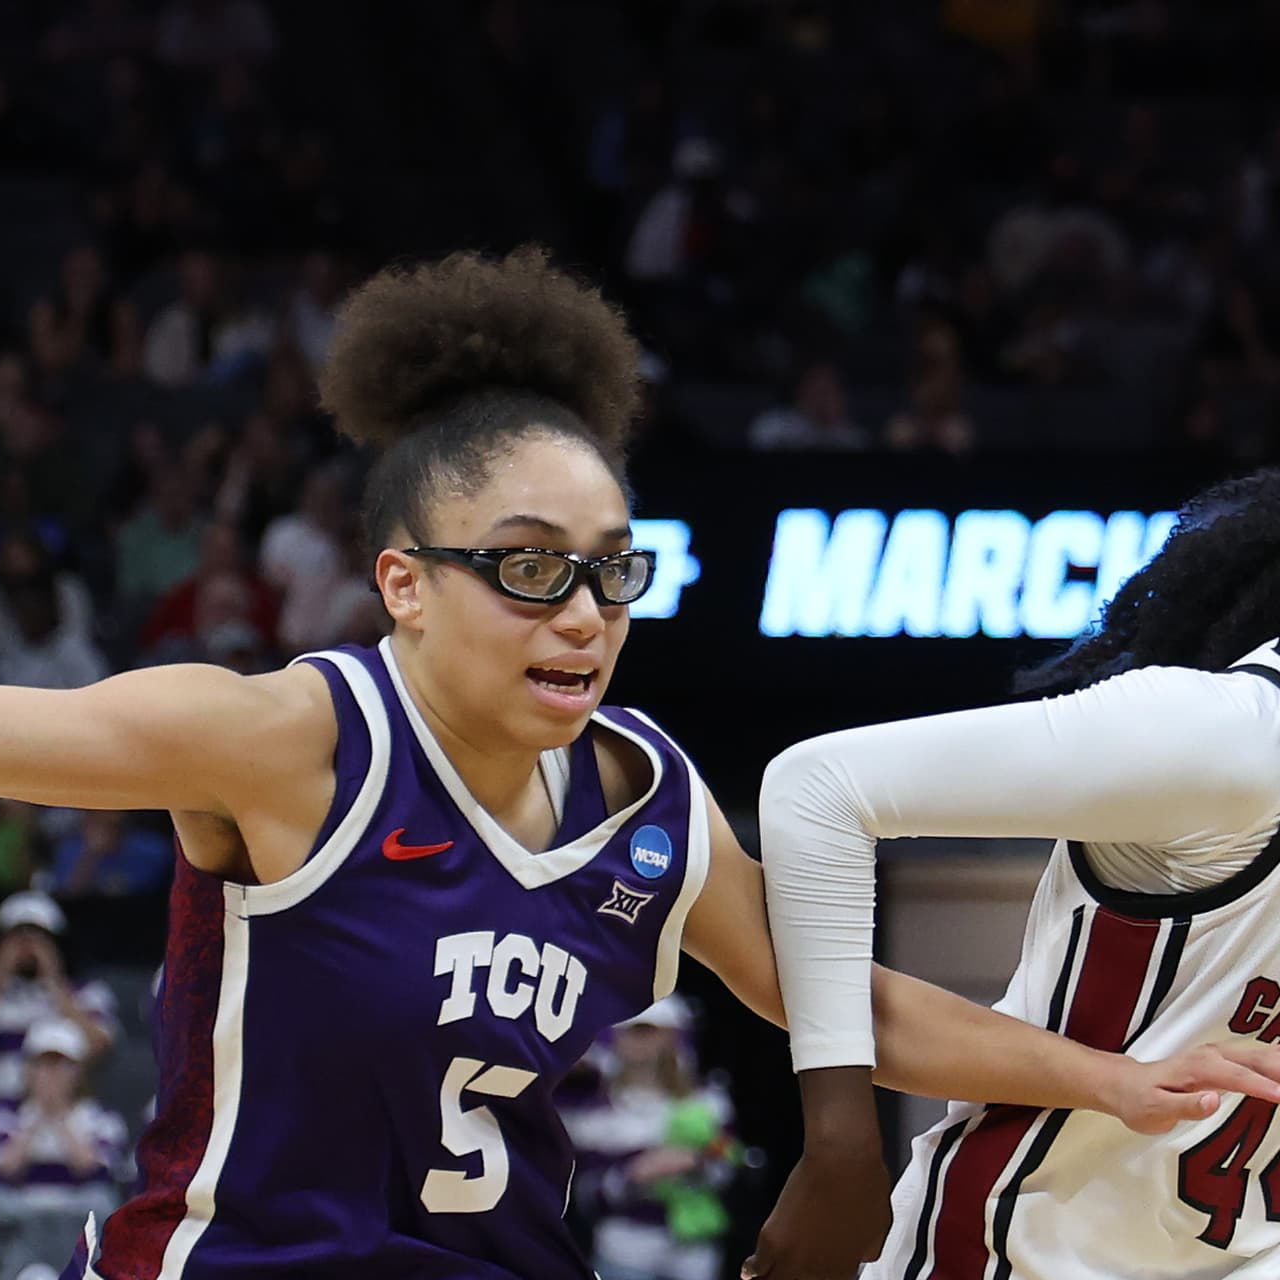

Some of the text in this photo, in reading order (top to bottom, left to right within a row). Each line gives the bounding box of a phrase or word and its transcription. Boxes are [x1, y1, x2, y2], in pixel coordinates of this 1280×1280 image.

[634, 846, 669, 870] NCAA
[433, 930, 588, 1044] TCU
[419, 1056, 540, 1214] 5
